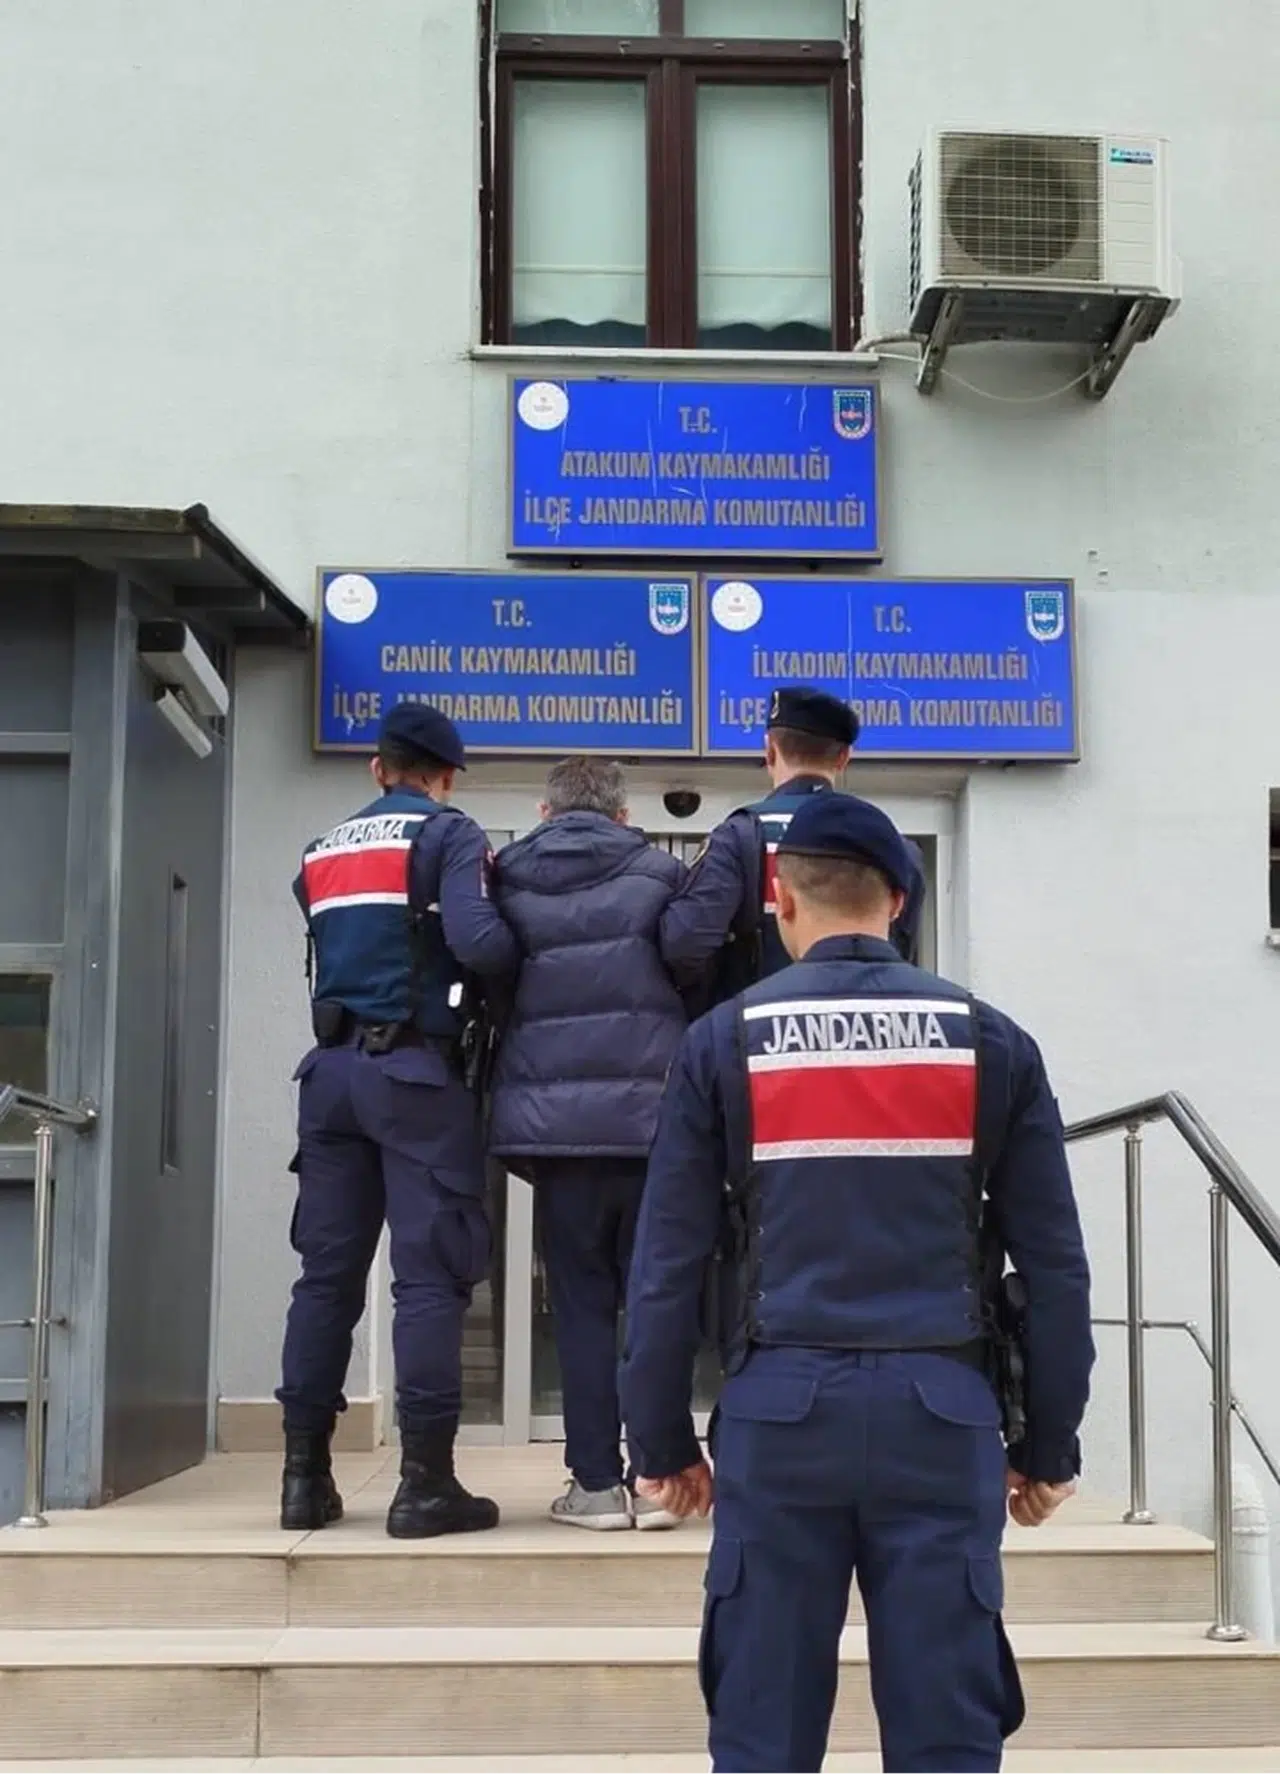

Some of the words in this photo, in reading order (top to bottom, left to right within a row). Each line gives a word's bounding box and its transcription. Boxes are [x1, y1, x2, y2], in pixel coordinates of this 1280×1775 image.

[678, 406, 718, 434] T.C.
[560, 451, 650, 478] ATAKUM
[658, 446, 831, 481] KAYMAKAMLIĞI
[524, 489, 572, 532] İLÇE
[578, 498, 707, 526] JANDARMA
[714, 493, 866, 528] KOMUTANLIĞI
[492, 599, 533, 628] T.C.
[873, 605, 913, 633] T.C.
[381, 640, 453, 673] CANİK
[460, 642, 637, 676] KAYMAKAMLIĞI
[752, 644, 847, 679] İLKADIM
[855, 645, 1029, 681] KAYMAKAMLIĞI
[333, 684, 382, 726] İLÇE
[528, 689, 683, 726] KOMUTANLIĞI
[719, 690, 768, 733] İLÇE
[909, 692, 1063, 727] KOMUTANLIĞI
[763, 1011, 950, 1055] JANDARMA
